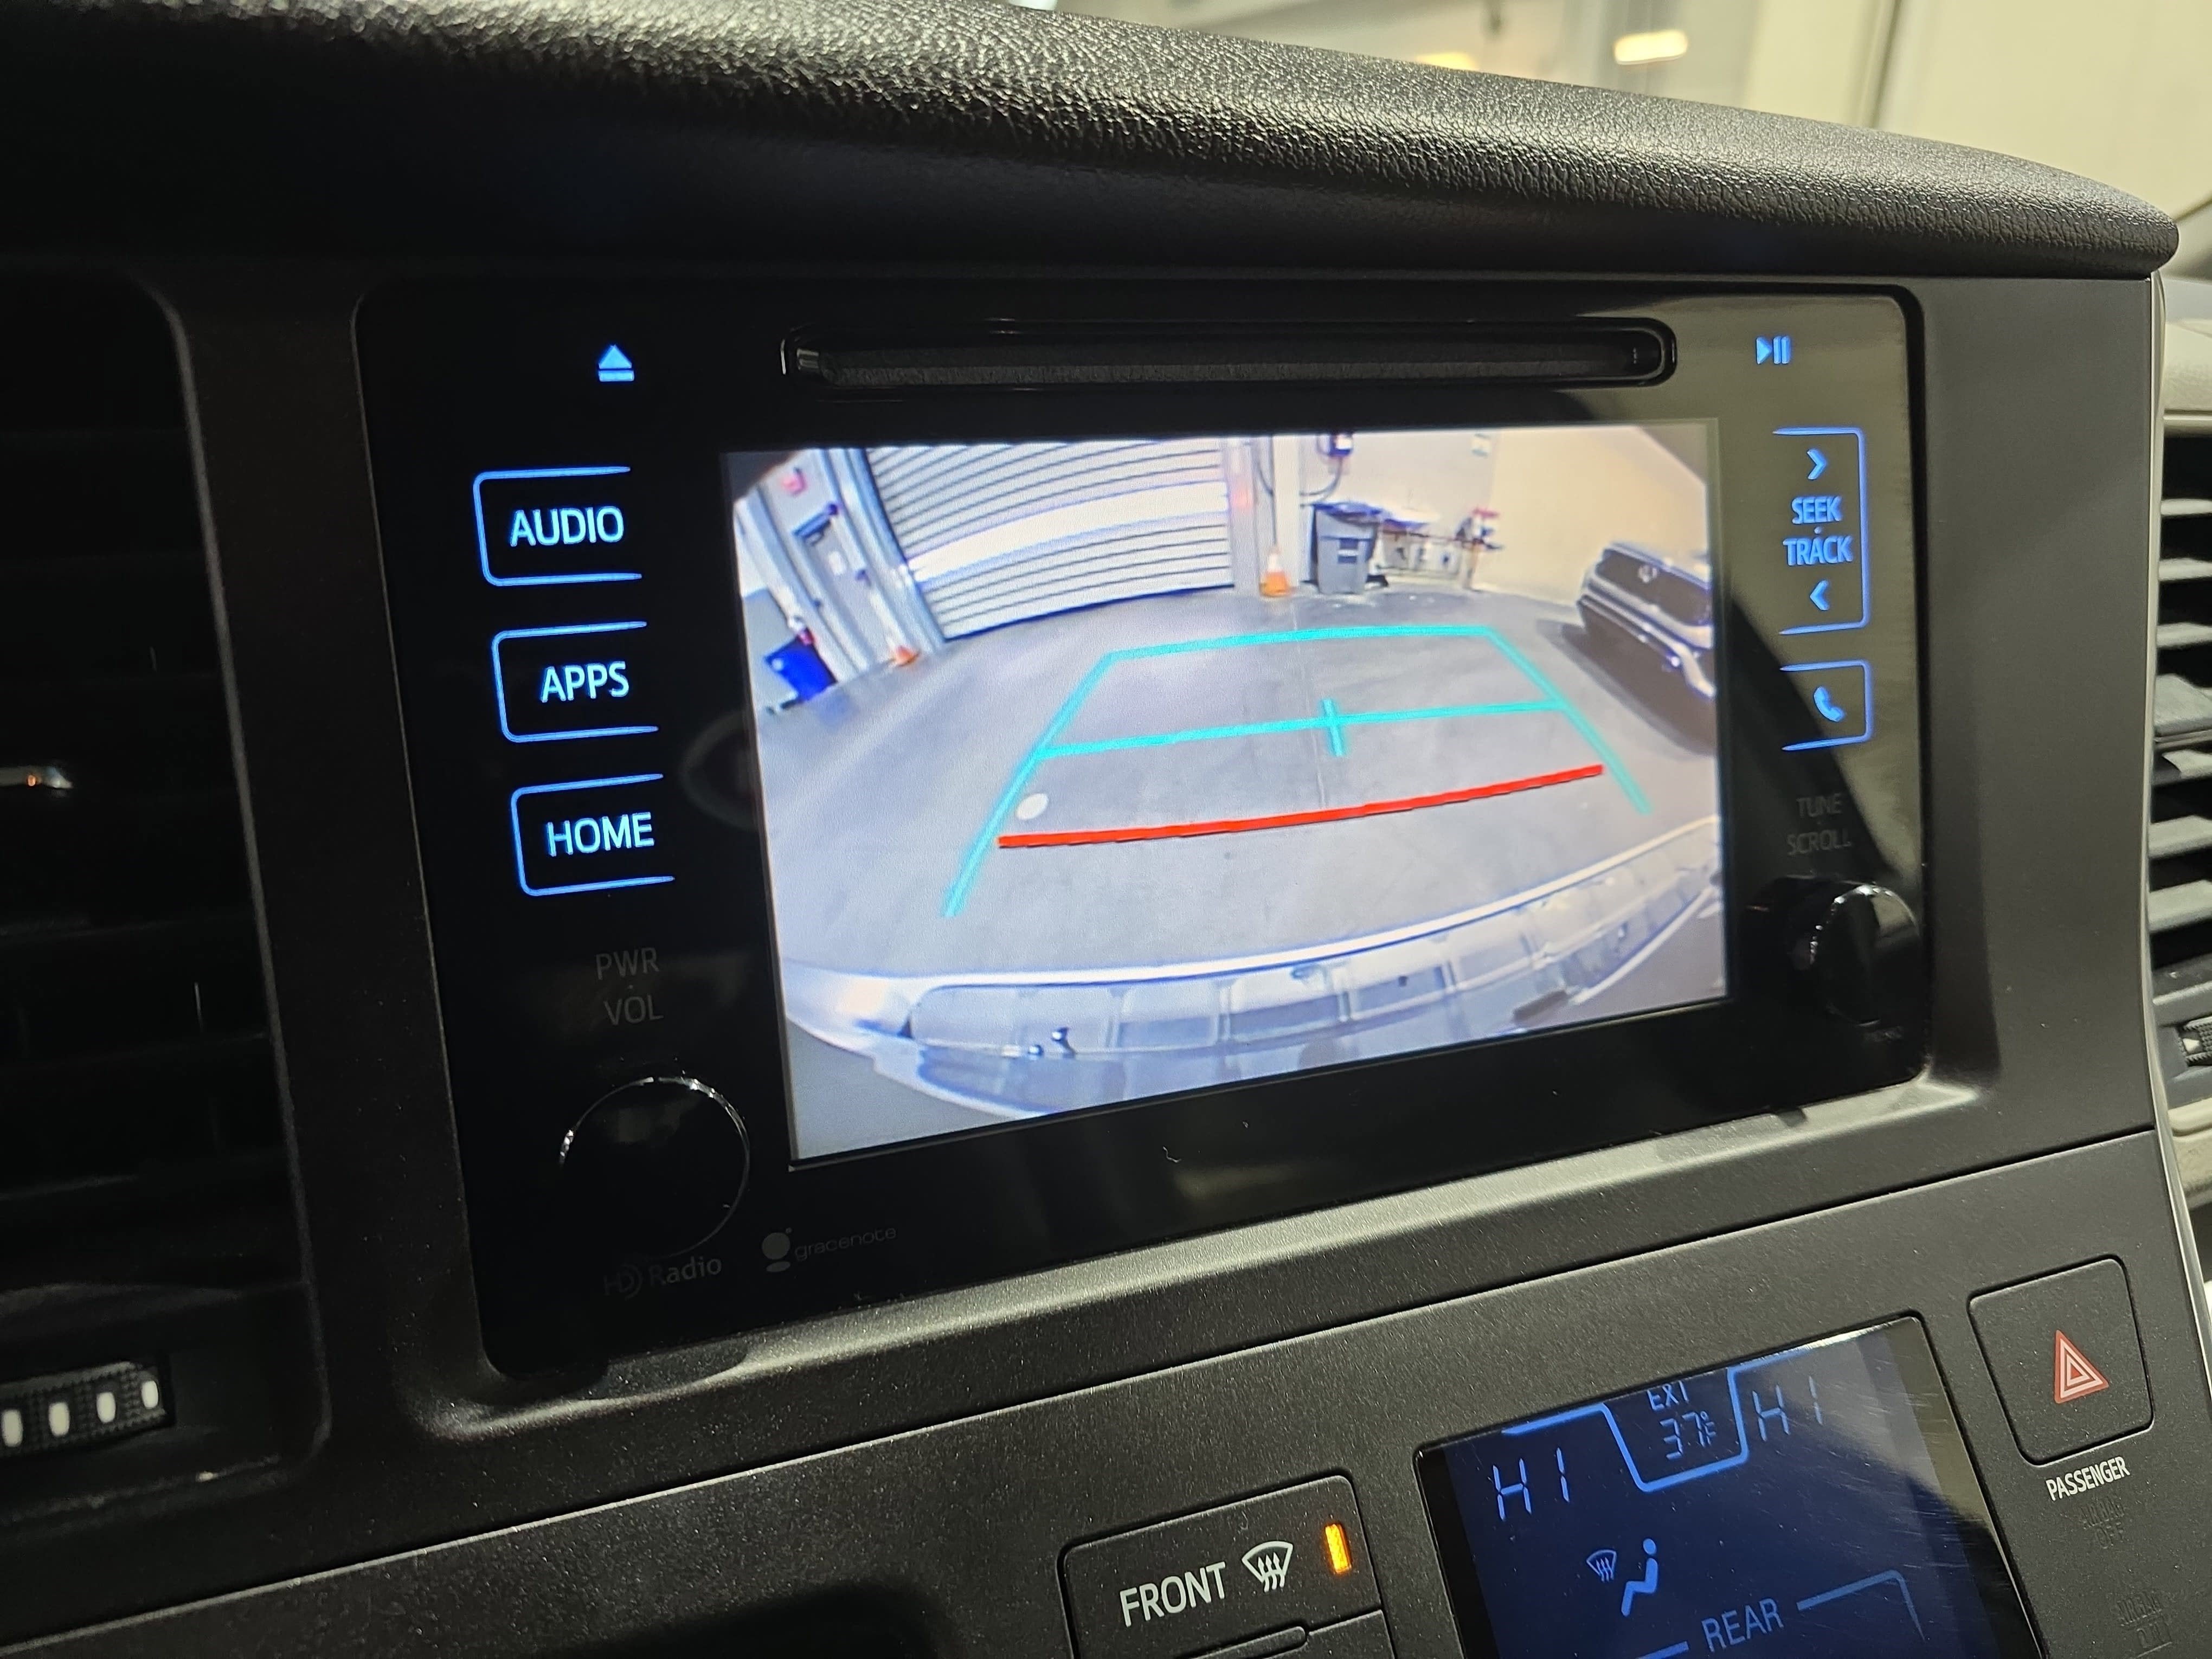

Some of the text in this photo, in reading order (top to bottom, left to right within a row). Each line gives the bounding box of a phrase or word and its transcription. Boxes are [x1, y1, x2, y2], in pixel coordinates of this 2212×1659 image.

[510, 505, 624, 548] AUDIO
[1791, 496, 1843, 525] SEEK
[1782, 535, 1854, 566] TRACK
[540, 661, 629, 703] APPS
[1796, 793, 1843, 818] TUNE
[546, 811, 655, 858] HOME
[1787, 829, 1853, 856] SCROLL
[595, 947, 659, 980] PWR
[604, 995, 663, 1026] VOL
[794, 1227, 897, 1262] gracenote
[649, 1255, 722, 1287] Radio
[2046, 1456, 2131, 1501] PASSENGER
[1120, 1561, 1226, 1627] FRONT
[1701, 1598, 1784, 1653] REAR
